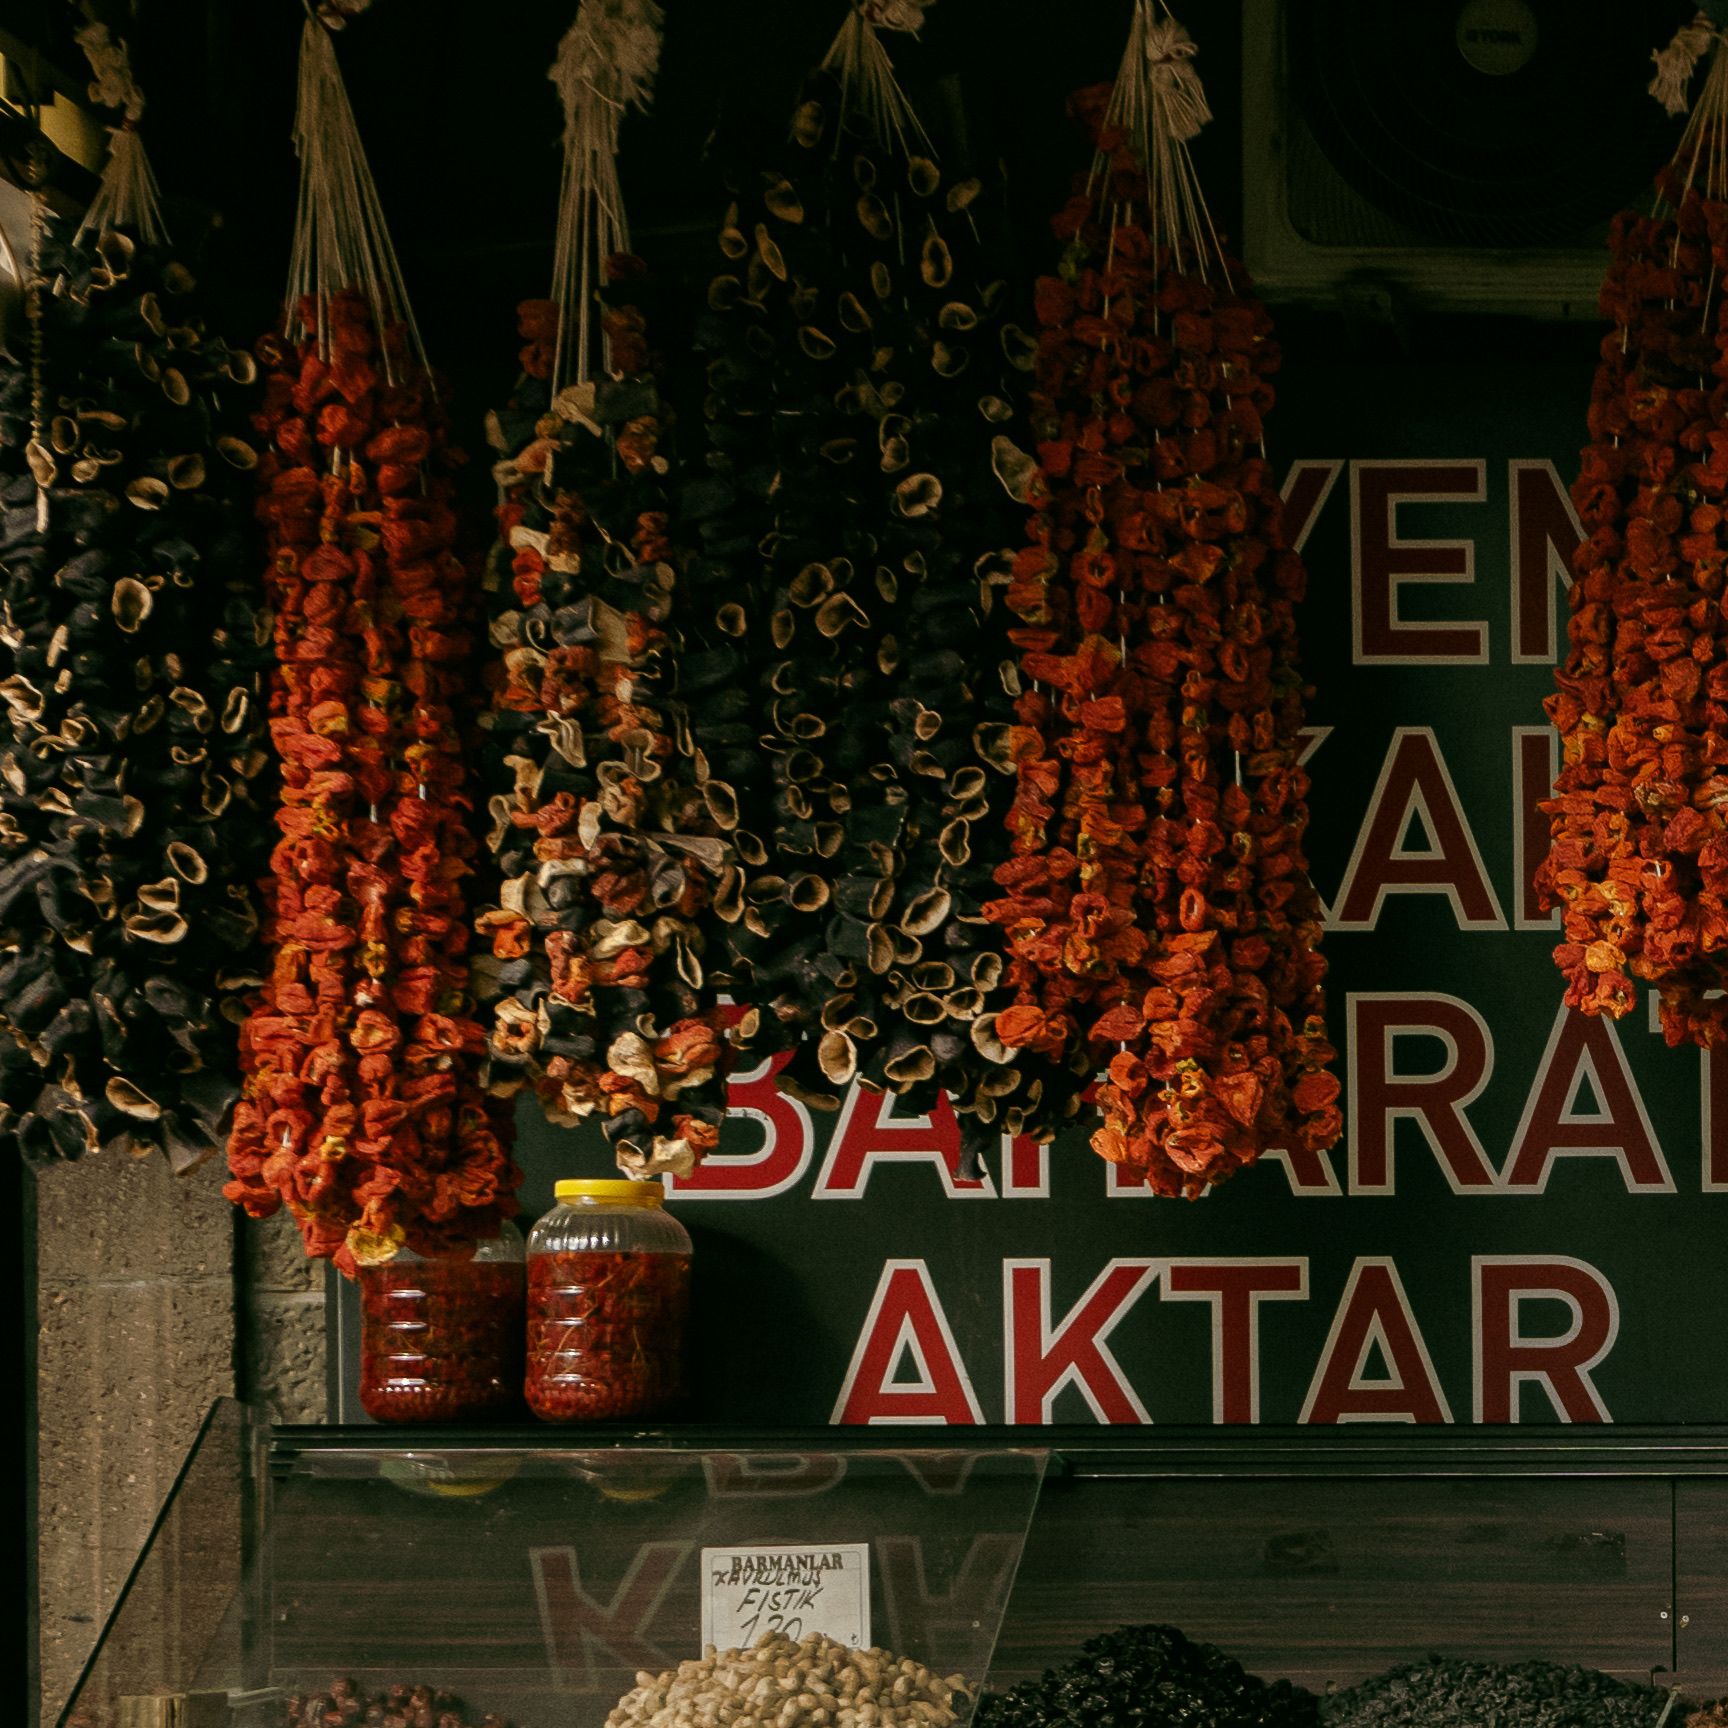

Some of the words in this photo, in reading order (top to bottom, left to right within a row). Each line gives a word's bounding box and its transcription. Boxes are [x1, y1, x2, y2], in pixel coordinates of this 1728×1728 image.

[830, 1255, 1619, 1425] AKTAR
[732, 1553, 843, 1571] BARMANLAR
[736, 1587, 823, 1613] FISTIK
